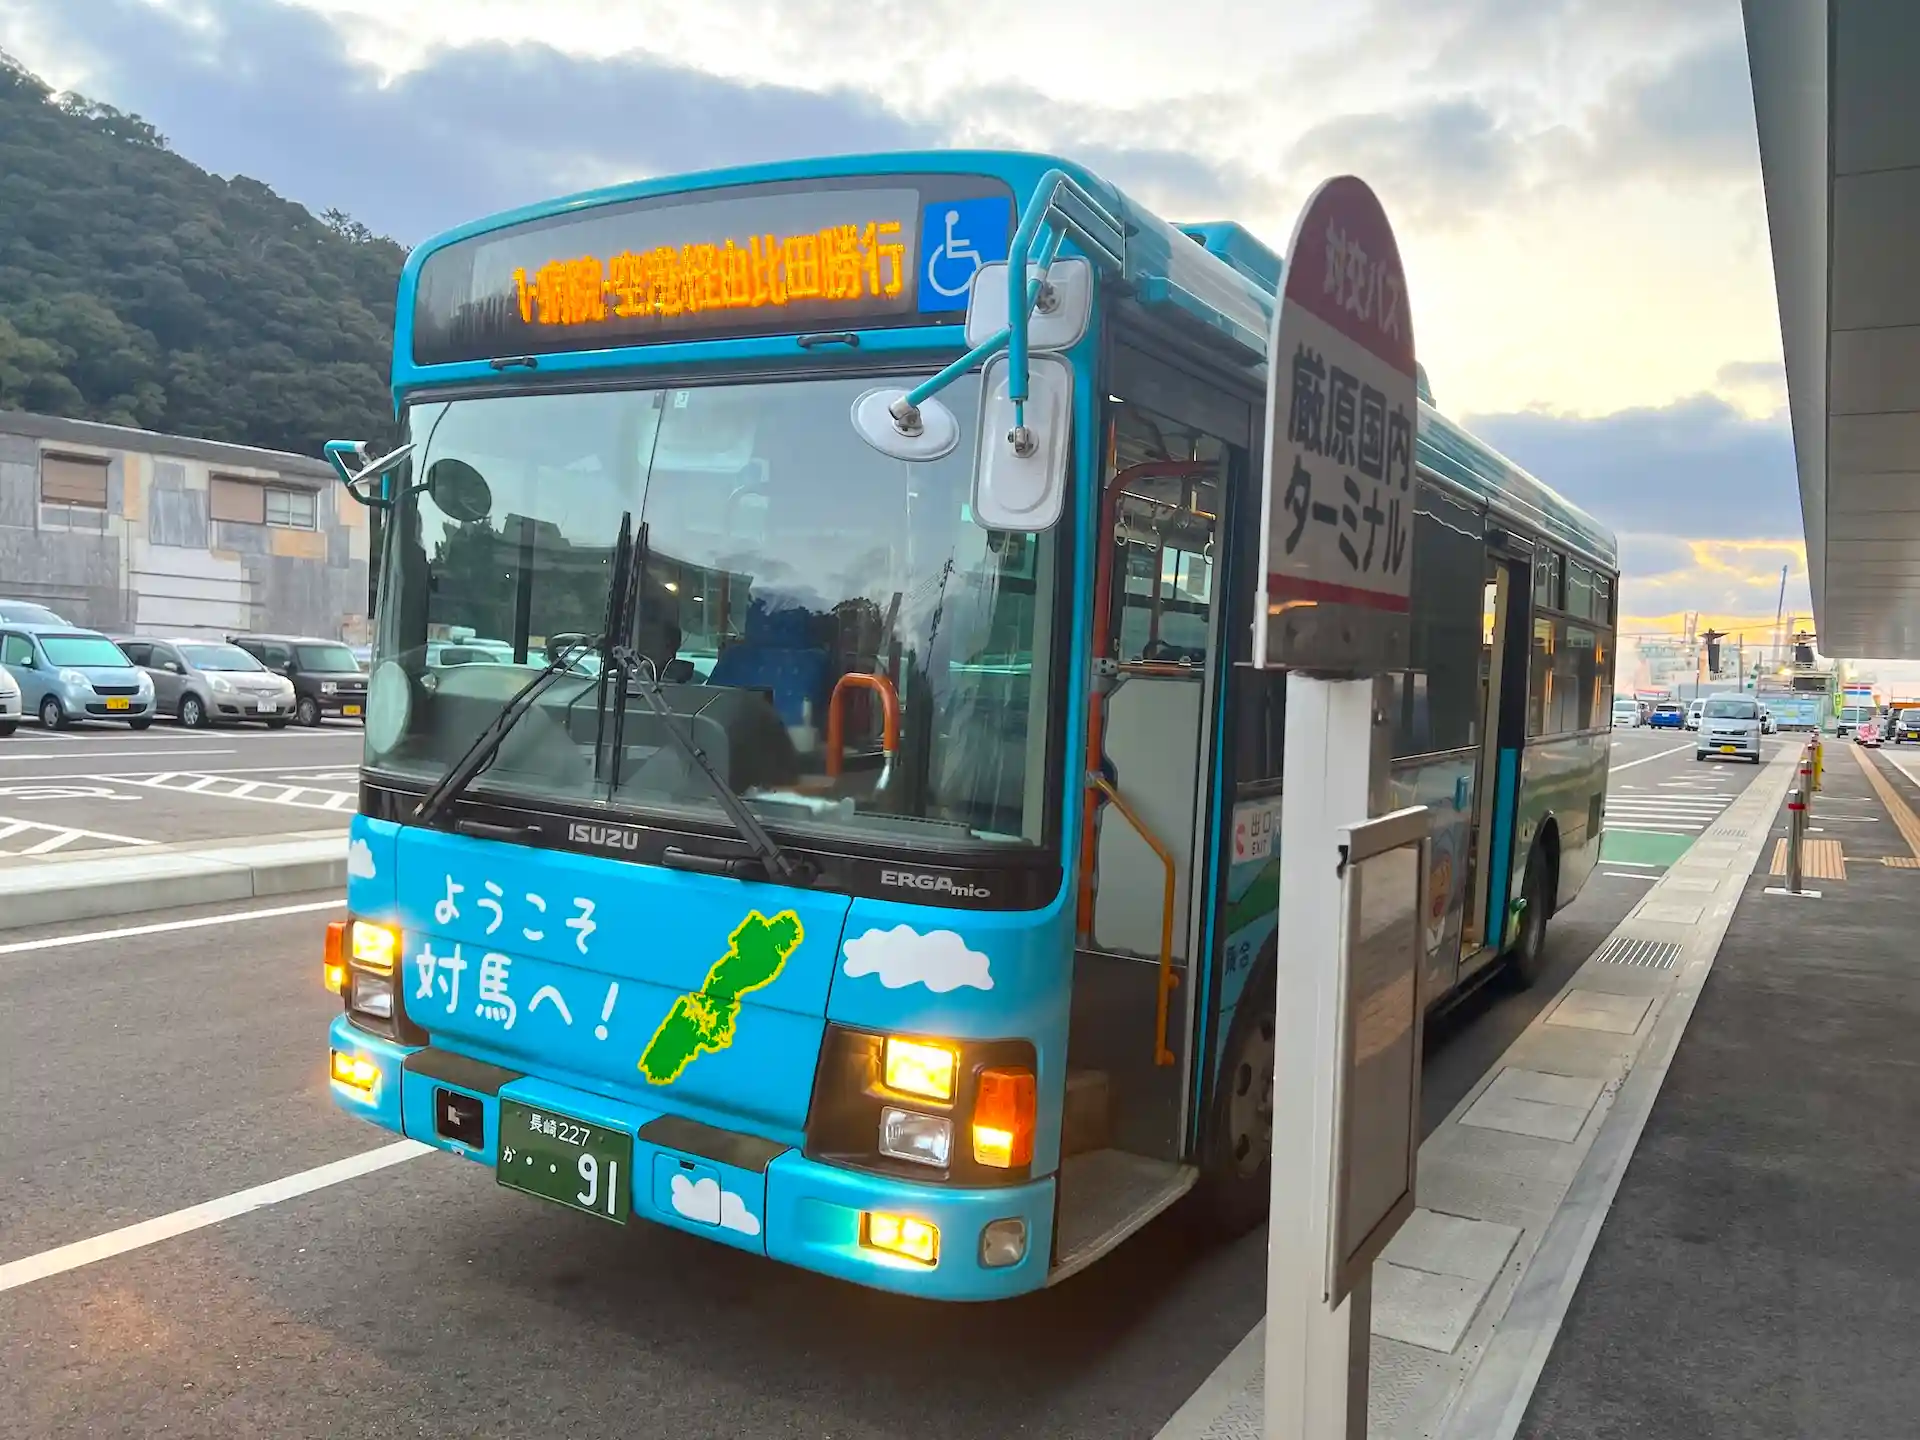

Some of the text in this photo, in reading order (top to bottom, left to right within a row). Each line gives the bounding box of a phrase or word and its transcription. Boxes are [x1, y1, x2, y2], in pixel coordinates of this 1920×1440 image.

[1288, 342, 1412, 493] 厳原国内
[1284, 454, 1407, 577] ターミナル
[568, 823, 639, 850] ISUZU
[1251, 811, 1271, 836] 出口
[1251, 839, 1267, 856] EXIT
[434, 873, 597, 954] ようこそ
